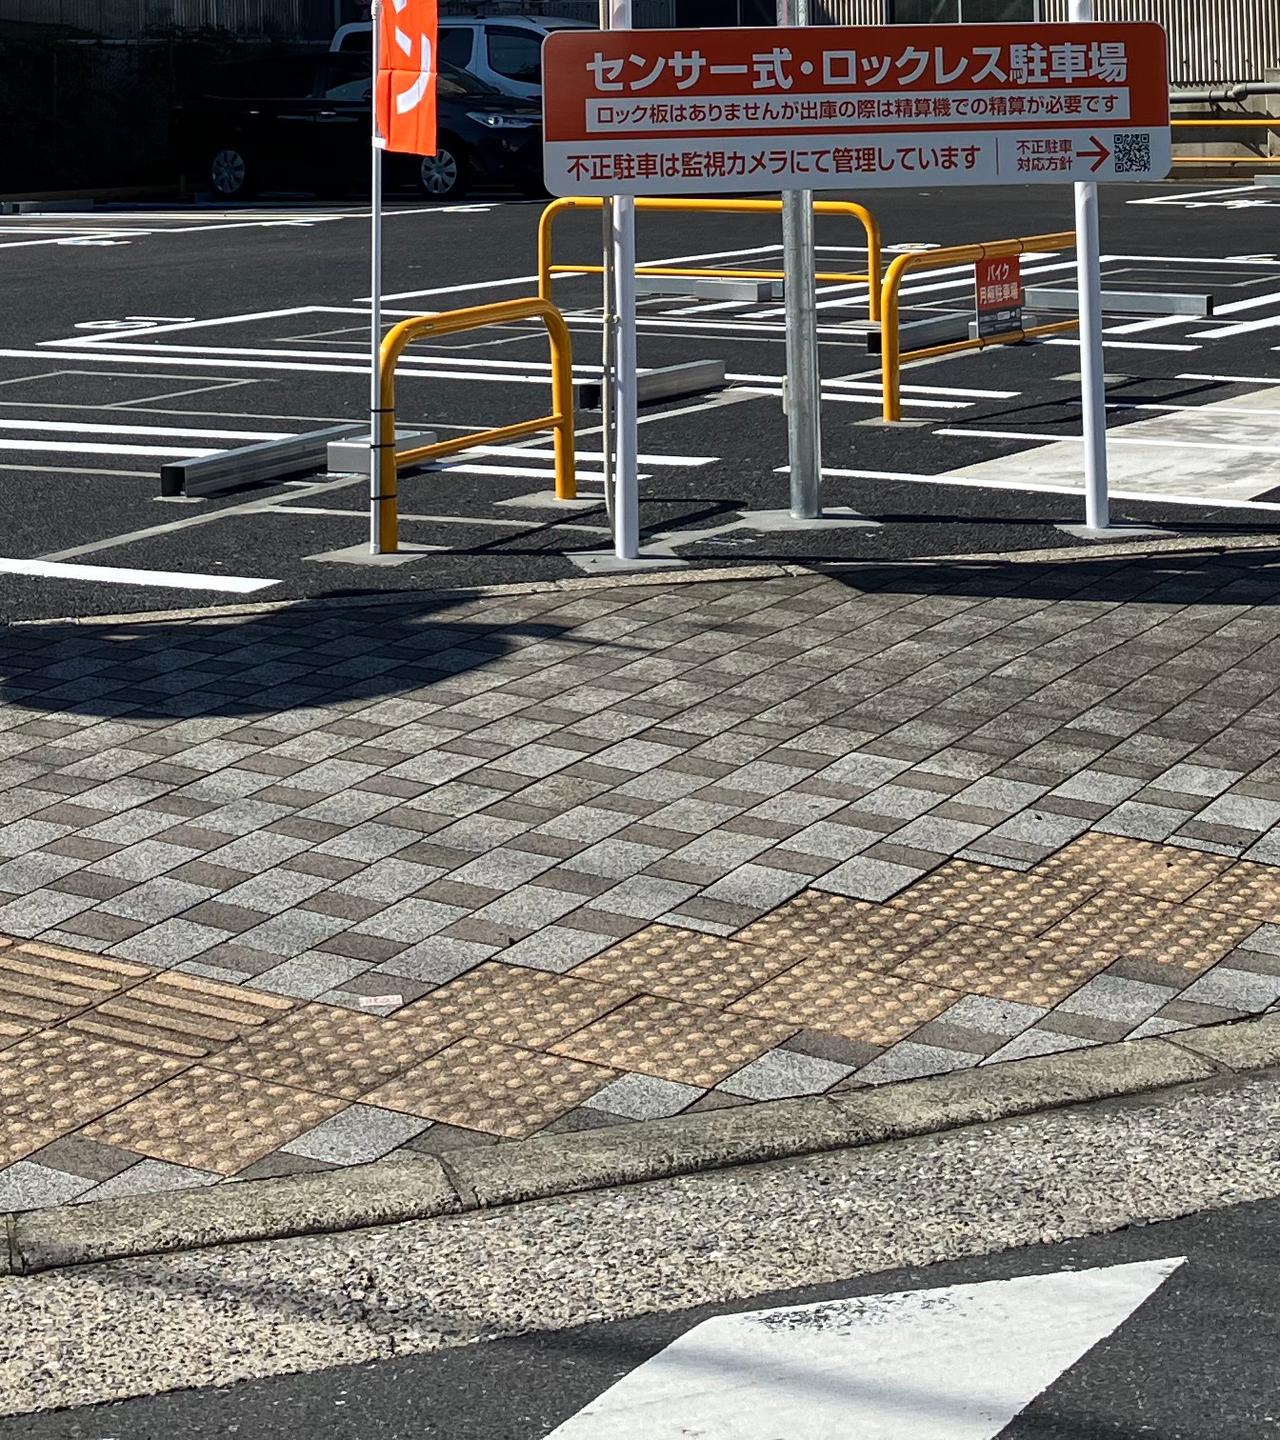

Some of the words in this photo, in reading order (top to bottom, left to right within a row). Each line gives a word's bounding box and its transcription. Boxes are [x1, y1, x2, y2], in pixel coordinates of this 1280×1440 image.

[586, 42, 1128, 92] センサー式・ロックレス駐車場
[597, 94, 1119, 125] ロック板はありませんが出庫の際は精算機での精算が必要です
[1016, 139, 1072, 155] 不正駐車
[567, 144, 981, 182] 不正駐車は監視カメラにて管理しています
[1017, 158, 1072, 172] 対応方針
[987, 263, 1009, 282] バイク
